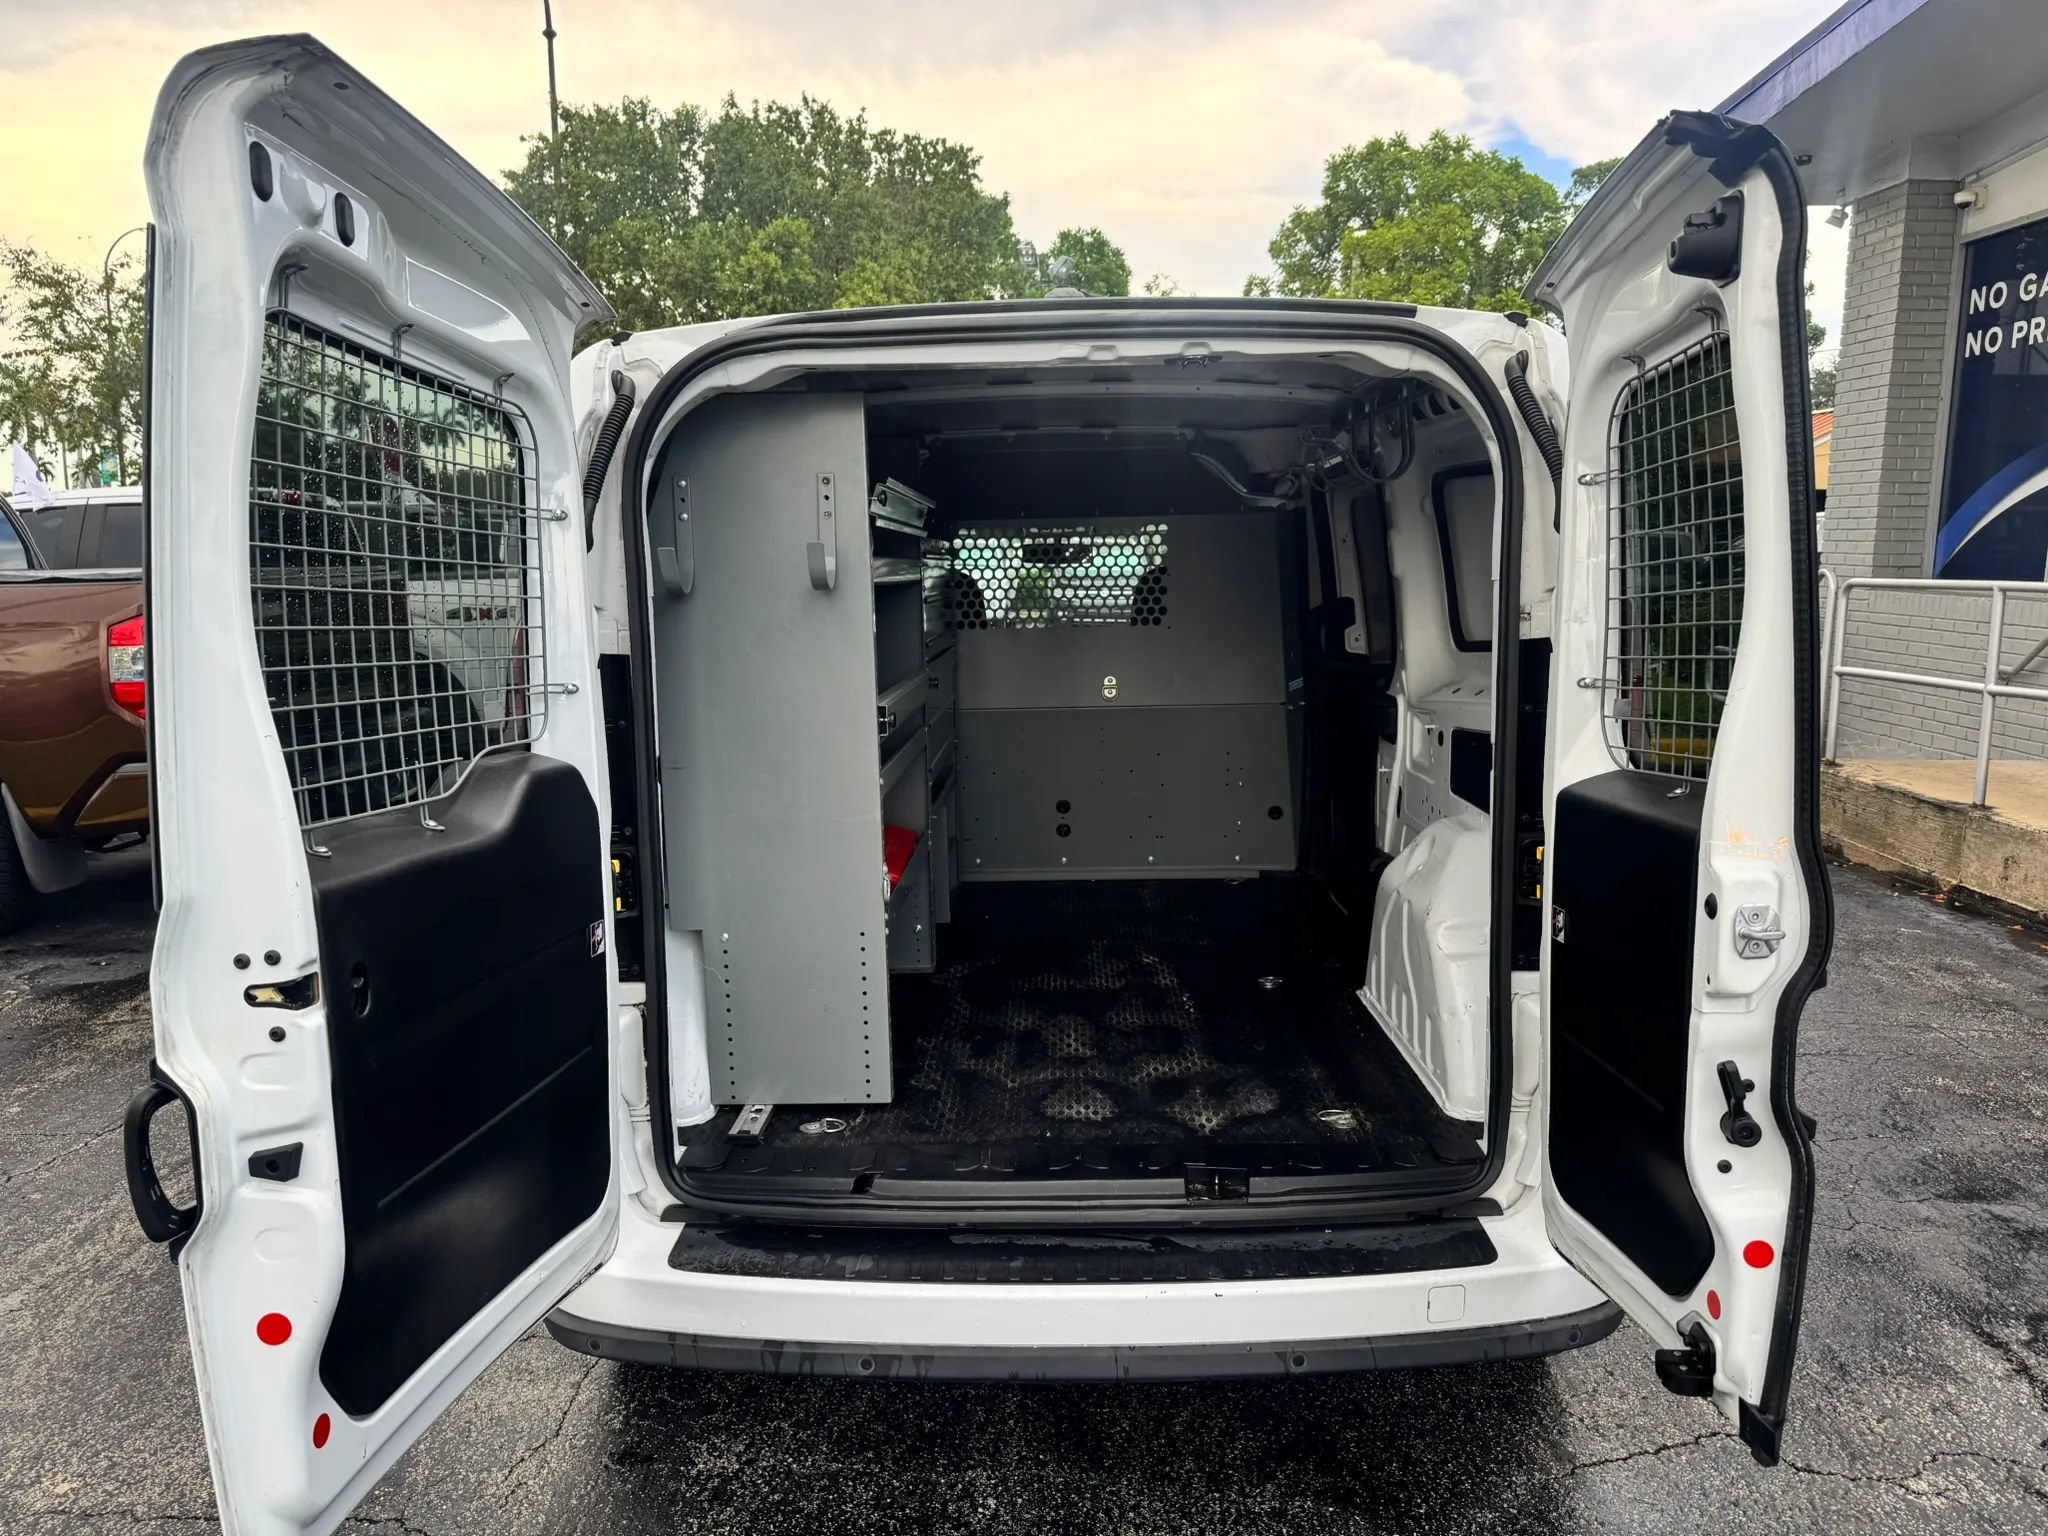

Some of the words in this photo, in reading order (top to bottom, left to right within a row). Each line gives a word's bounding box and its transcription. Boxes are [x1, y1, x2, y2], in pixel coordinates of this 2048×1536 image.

[1969, 281, 2008, 315] NO
[1964, 326, 2003, 358] NO
[2011, 316, 2048, 349] PR
